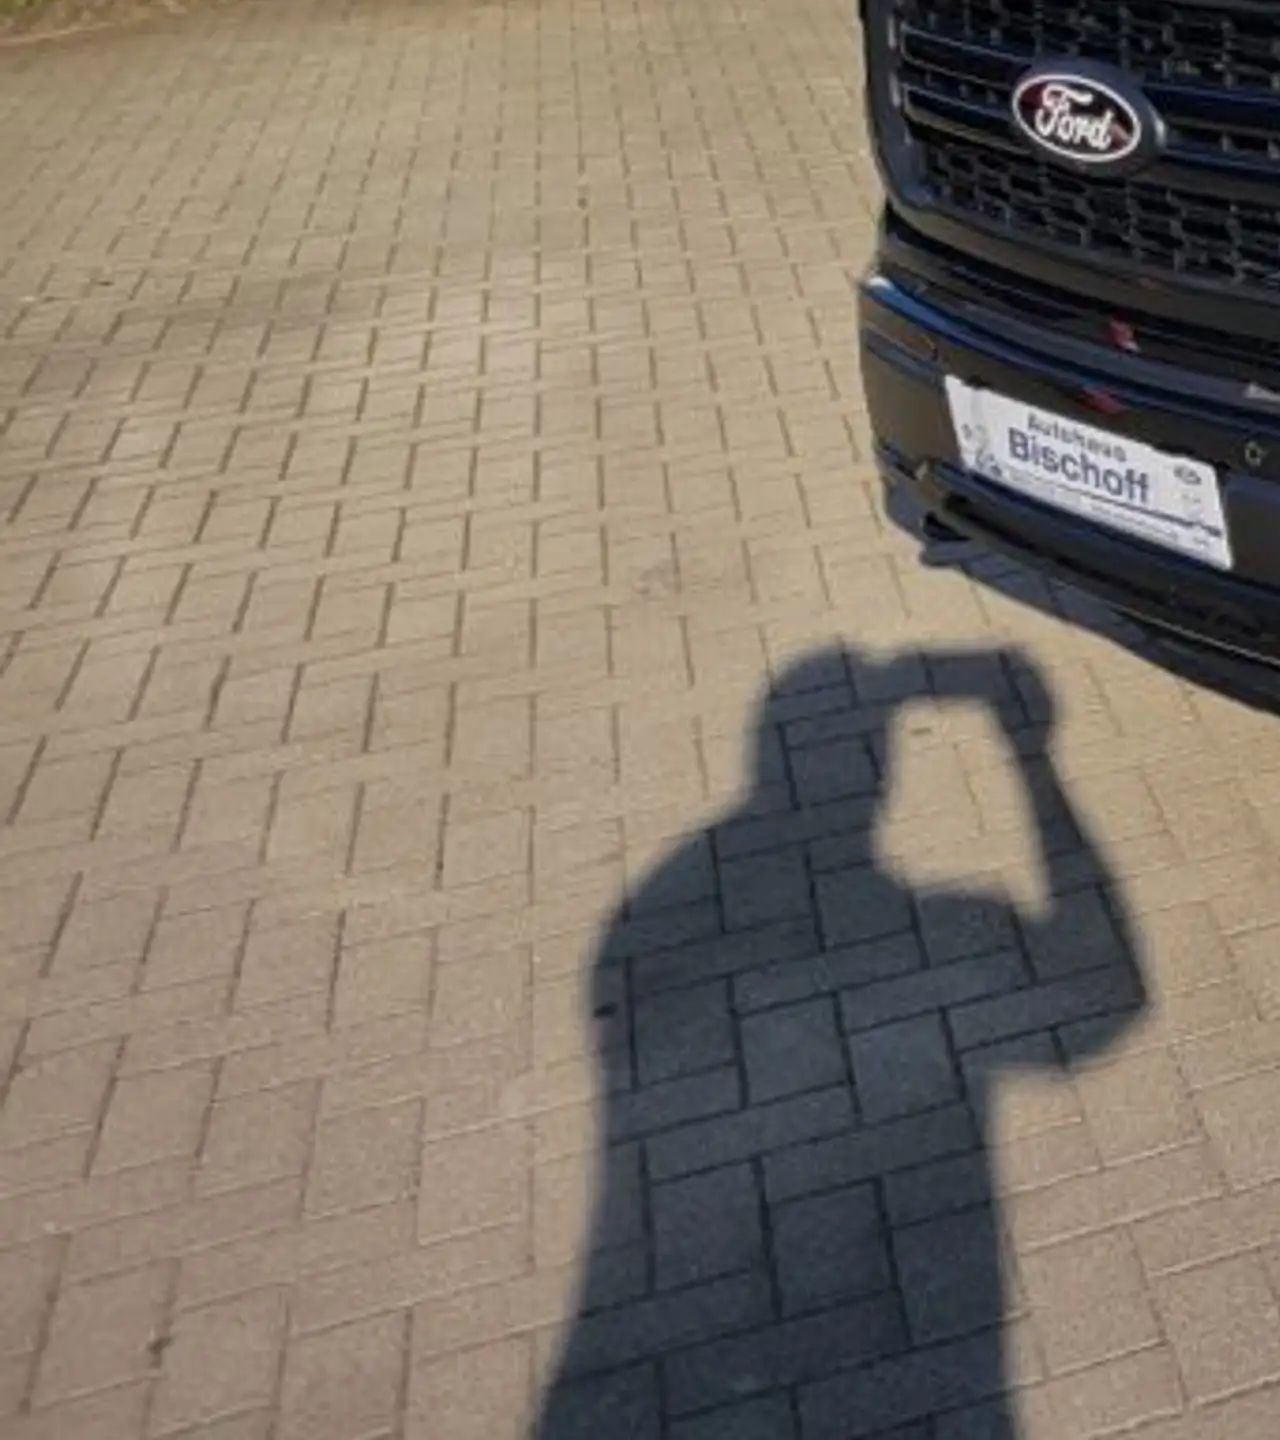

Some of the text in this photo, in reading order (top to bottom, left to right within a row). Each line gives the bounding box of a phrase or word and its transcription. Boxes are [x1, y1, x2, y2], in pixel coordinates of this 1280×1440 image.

[1034, 81, 1115, 151] Ford
[1008, 426, 1150, 503] Bischoff
[1027, 412, 1127, 463] Autohaus
